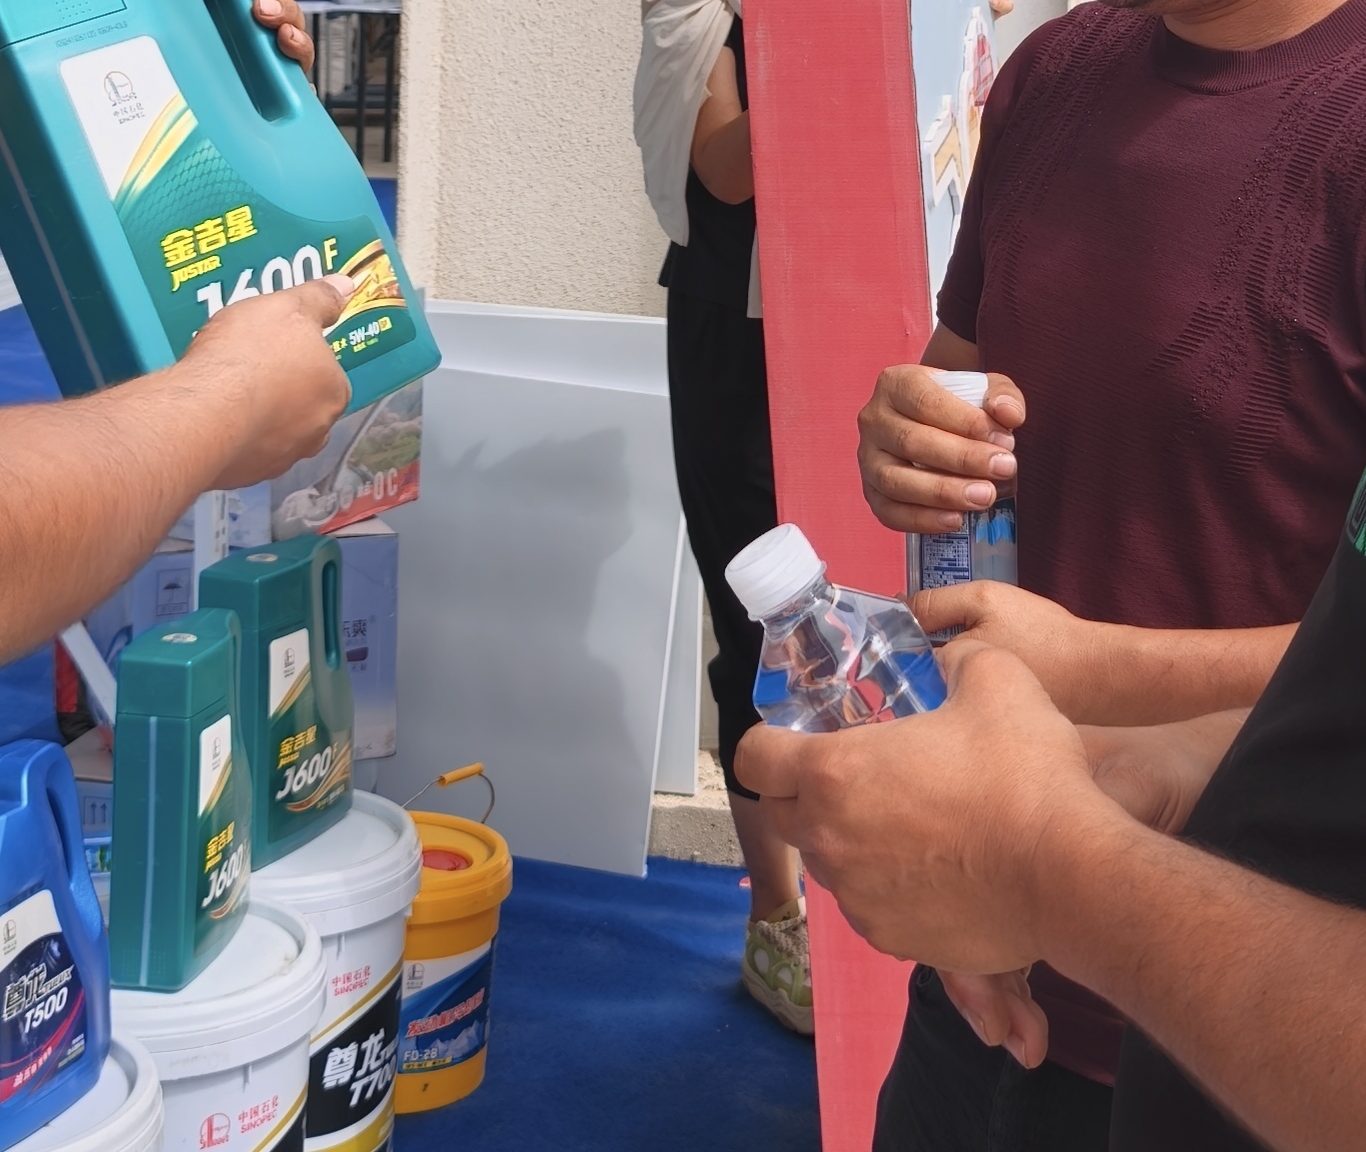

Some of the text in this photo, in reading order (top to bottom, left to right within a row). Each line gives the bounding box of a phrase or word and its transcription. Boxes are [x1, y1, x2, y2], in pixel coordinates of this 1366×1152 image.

[160, 205, 258, 268] 金吉星
[279, 724, 317, 757] 金吉星
[332, 965, 371, 986] 中国石化
[23, 986, 68, 1034] T500
[323, 1027, 385, 1091] 尊龙
[404, 1048, 439, 1062] FD-28
[238, 1095, 279, 1121] 中国石化
[241, 1109, 278, 1134] SINOPEC
